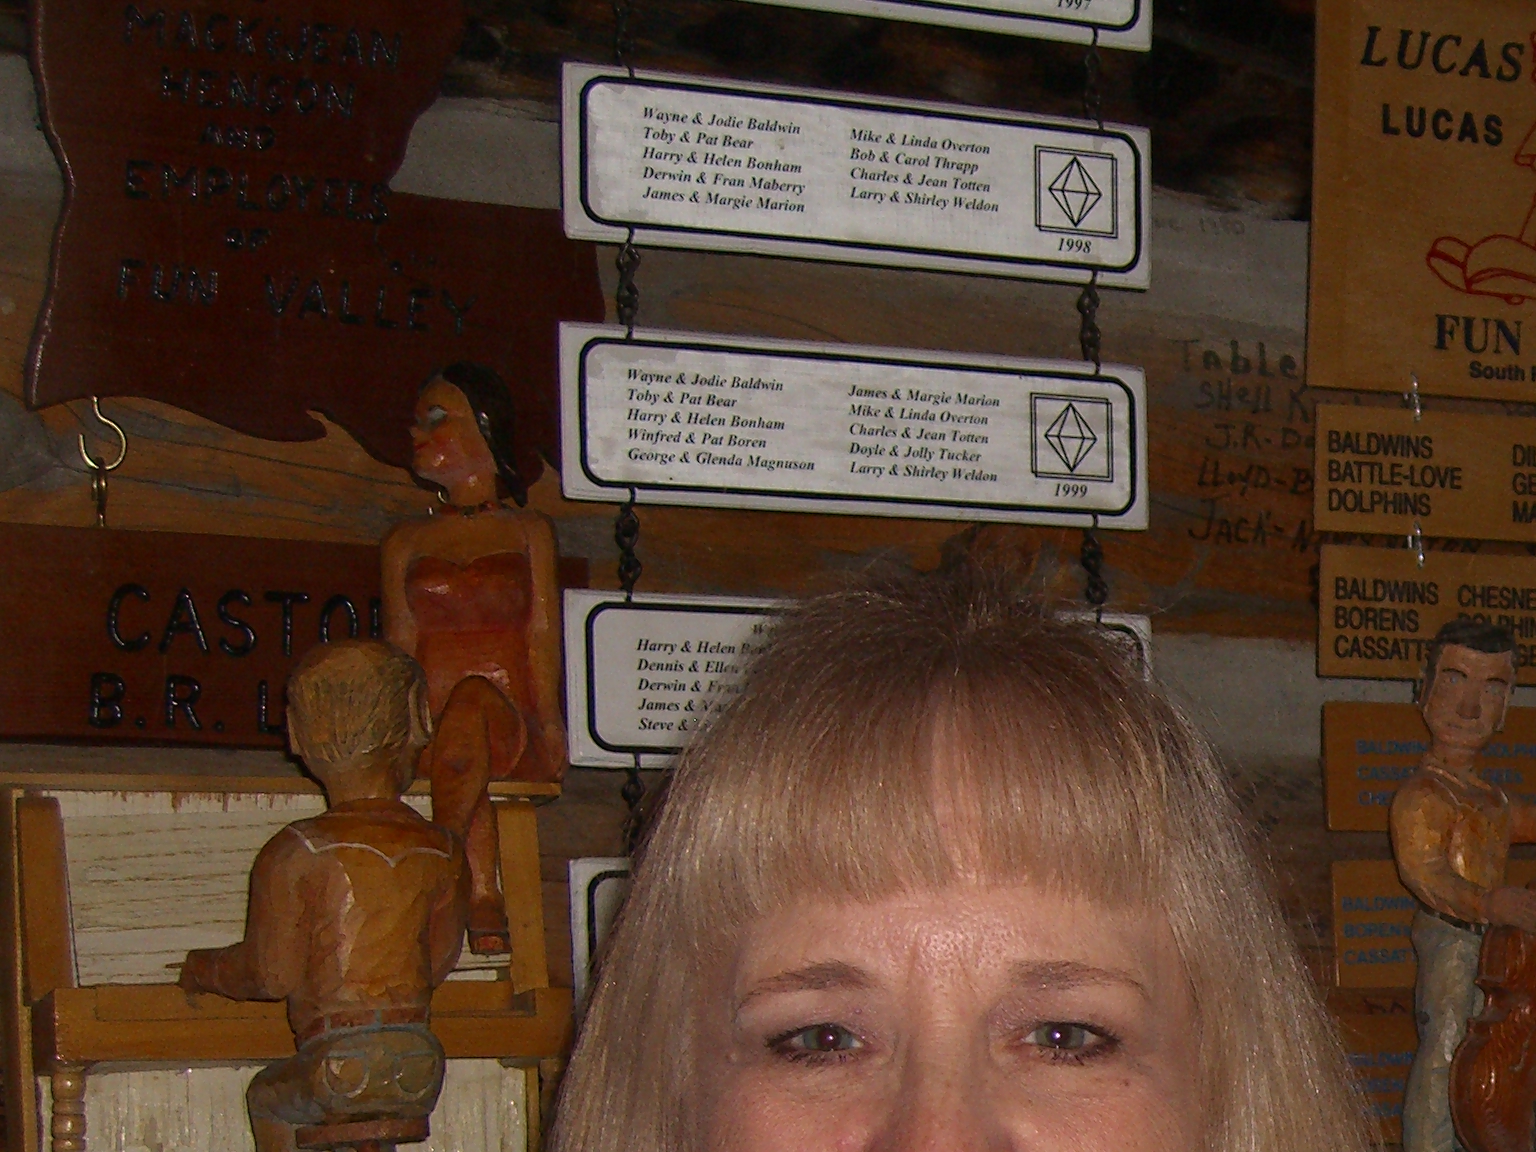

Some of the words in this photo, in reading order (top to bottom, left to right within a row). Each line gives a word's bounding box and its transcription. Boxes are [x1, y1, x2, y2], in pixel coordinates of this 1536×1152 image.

[1360, 25, 1525, 82] LUCAS
[160, 66, 356, 119] HENSON
[644, 107, 688, 124] Wayne
[692, 112, 702, 125] &
[708, 114, 743, 128] Jodie
[747, 118, 800, 134] Baldwin
[1382, 103, 1503, 146] LUCAS
[200, 123, 276, 151] AND
[644, 127, 675, 144] Toby
[680, 131, 690, 143] &
[696, 132, 718, 146] Pat
[722, 135, 754, 148] Bear
[850, 128, 882, 143] Mike
[886, 133, 896, 144] &
[902, 134, 937, 149] Linda
[942, 139, 990, 154] Overton
[643, 147, 683, 165] Harry
[687, 151, 697, 163] &
[704, 153, 741, 168] Helen
[747, 157, 801, 173] Bonham
[850, 148, 875, 161] Bob
[879, 151, 889, 163] &
[895, 153, 930, 167] Carol
[935, 156, 978, 175] Thrapp
[643, 167, 691, 183] Derwin
[696, 171, 707, 184] &
[713, 174, 745, 188] Fran
[749, 177, 805, 196] Maberry
[850, 167, 899, 183] Charles
[903, 173, 912, 185] &
[918, 174, 947, 187] Jean
[953, 176, 990, 192] Totten
[124, 160, 391, 224] EMPLOYEES
[642, 187, 685, 201] James
[689, 191, 700, 203] &
[705, 192, 752, 209] Margie
[757, 197, 804, 212] Marion
[850, 187, 886, 204] Larry
[890, 191, 899, 203] &
[905, 192, 949, 210] Shirley
[954, 196, 998, 212] Weldon
[224, 227, 272, 250] OF
[1058, 238, 1091, 253] 1998
[116, 259, 220, 307] FUN
[264, 273, 478, 334] VALLEY
[1434, 314, 1523, 356] FUN
[628, 369, 672, 385] Wayne
[675, 373, 686, 385] &
[691, 374, 727, 387] Jodie
[731, 377, 783, 391] Baldwin
[1469, 361, 1525, 382] South
[628, 389, 660, 405] Toby
[663, 391, 674, 404] &
[680, 392, 702, 405] Pat
[706, 394, 737, 407] Bear
[848, 385, 887, 399] James
[891, 389, 901, 400] &
[907, 389, 951, 405] Margie
[955, 393, 999, 406] Marion
[627, 408, 667, 425] Harry
[671, 412, 681, 423] &
[687, 412, 725, 426] Helen
[731, 415, 784, 430] Bonham
[849, 404, 880, 417] Mike
[885, 407, 893, 418] &
[900, 408, 935, 421] Linda
[940, 411, 988, 424] Overton
[629, 428, 681, 445] Winfred
[685, 432, 695, 444] &
[702, 433, 723, 446] Pat
[728, 435, 766, 448] Boren
[850, 423, 897, 437] Charles
[901, 427, 911, 439] &
[916, 428, 946, 441] Jean
[952, 430, 988, 444] Totten
[1328, 430, 1433, 459] BALDWINS
[628, 448, 675, 465] George
[680, 451, 690, 463] &
[696, 452, 742, 466] Glenda
[747, 455, 814, 471] Magnuson
[849, 442, 885, 458] Doyle
[889, 445, 898, 457] &
[904, 446, 935, 462] Jolly
[940, 448, 981, 461] Tucker
[850, 462, 885, 478] Larry
[889, 464, 898, 476] &
[903, 465, 948, 481] Shirley
[953, 468, 997, 481] Weldon
[1328, 459, 1462, 490] BATTLE-LOVE
[1055, 483, 1087, 498] 1999
[1328, 488, 1431, 517] DOLPHINS
[1335, 577, 1439, 605] BALDWINS
[1334, 605, 1419, 633] BORENS
[637, 639, 677, 655] Harry
[680, 641, 691, 653] &
[697, 641, 735, 653] Helen
[637, 659, 684, 672] Dennis
[688, 661, 699, 672] &
[638, 678, 686, 691] Derwin
[691, 681, 700, 692] &
[638, 698, 680, 711] James
[684, 700, 694, 711] &
[638, 718, 673, 730] Steve
[678, 720, 688, 731] &
